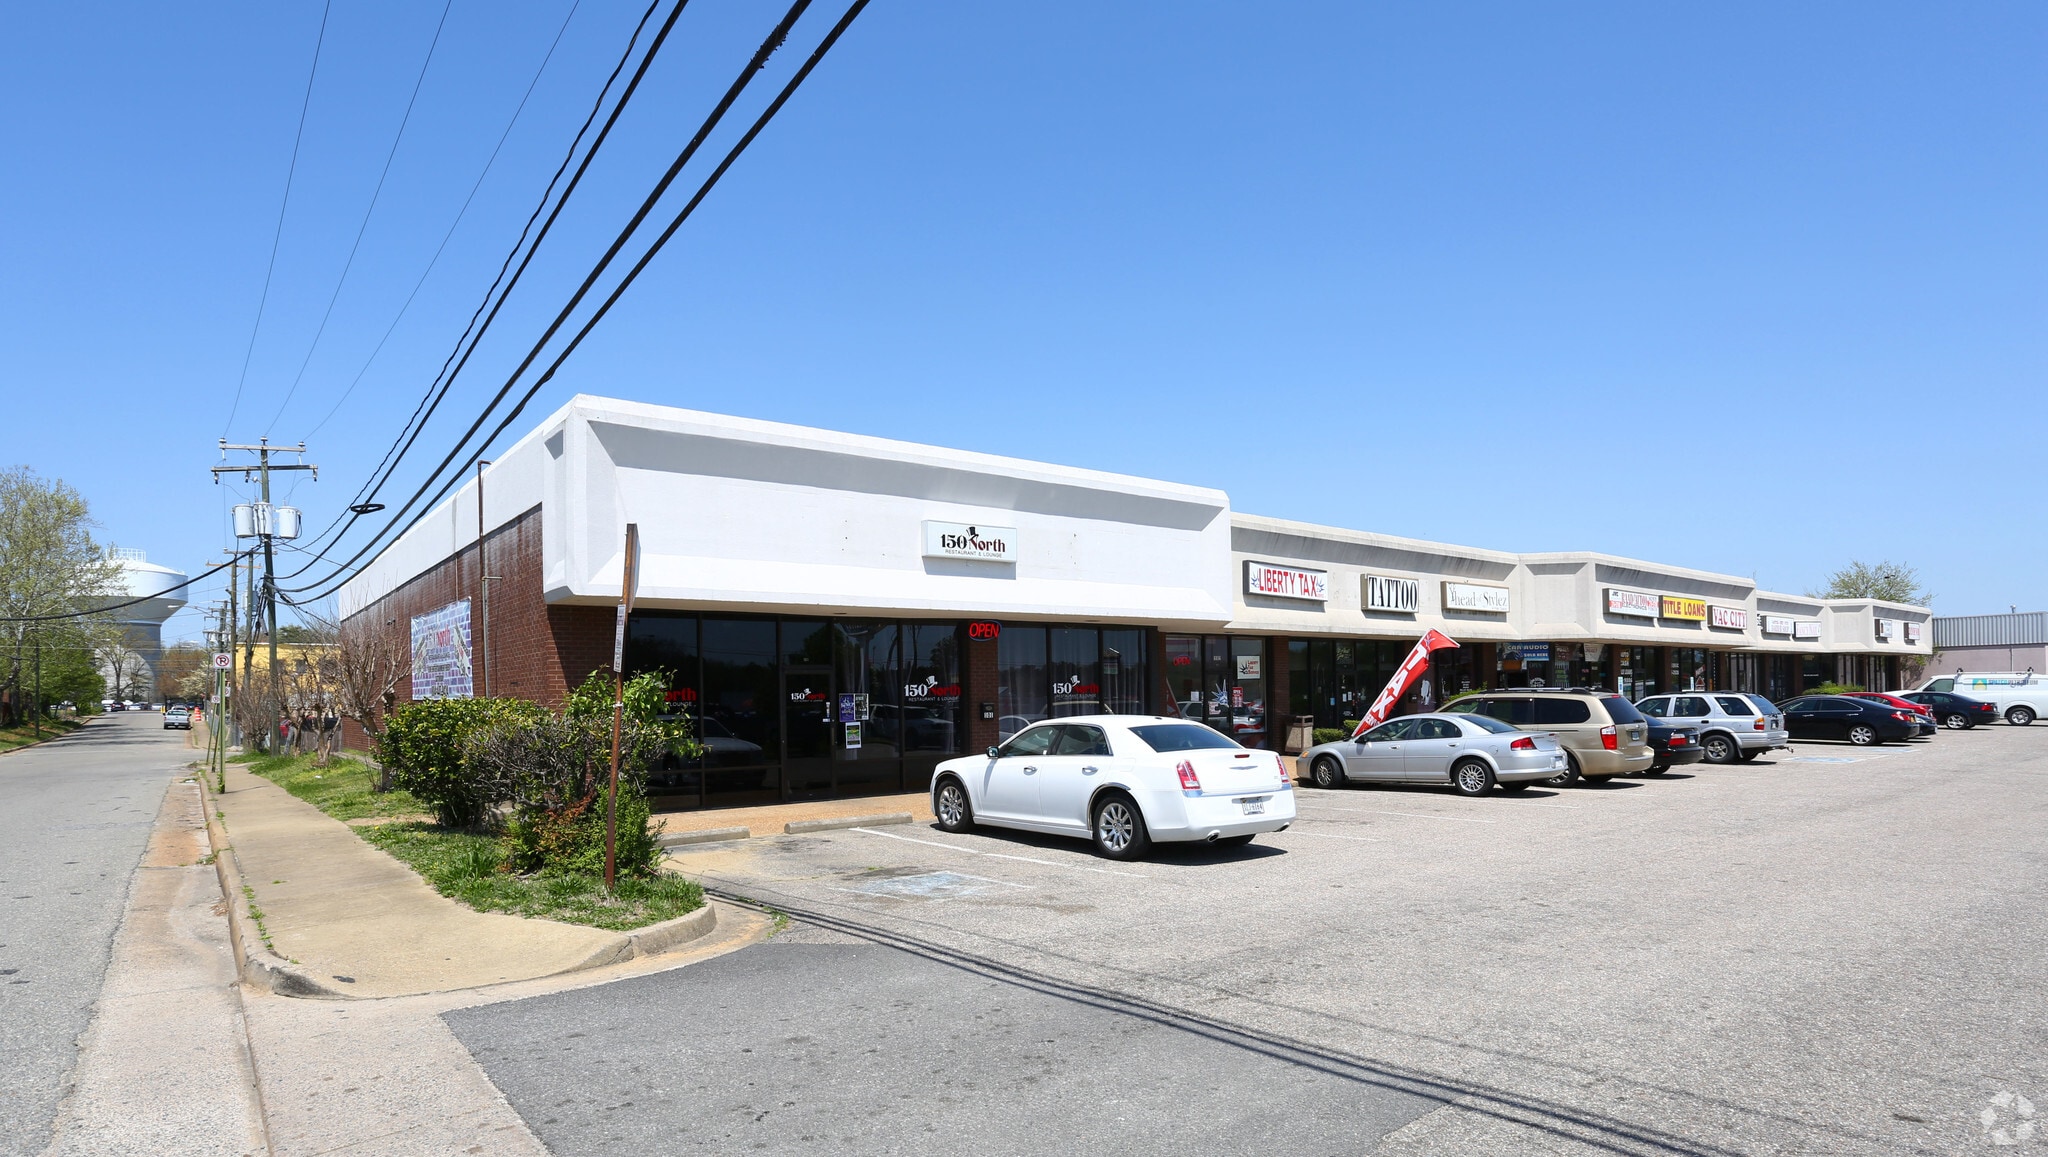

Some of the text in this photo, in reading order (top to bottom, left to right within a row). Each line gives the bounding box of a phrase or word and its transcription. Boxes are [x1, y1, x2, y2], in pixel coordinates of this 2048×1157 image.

[941, 534, 1006, 553] 150 North
[1259, 568, 1317, 597] LIBERTY TAX
[1369, 577, 1418, 611] TATTOO
[1663, 600, 1682, 615] TITLE
[1684, 602, 1706, 617] LOANS
[1713, 608, 1747, 627] VAC CITY
[969, 622, 999, 638] OPEN
[904, 683, 960, 697] 150 North
[1052, 682, 1072, 694] 150
[1371, 643, 1428, 721] TAX
[664, 687, 697, 701] orth
[791, 692, 805, 700] 150
